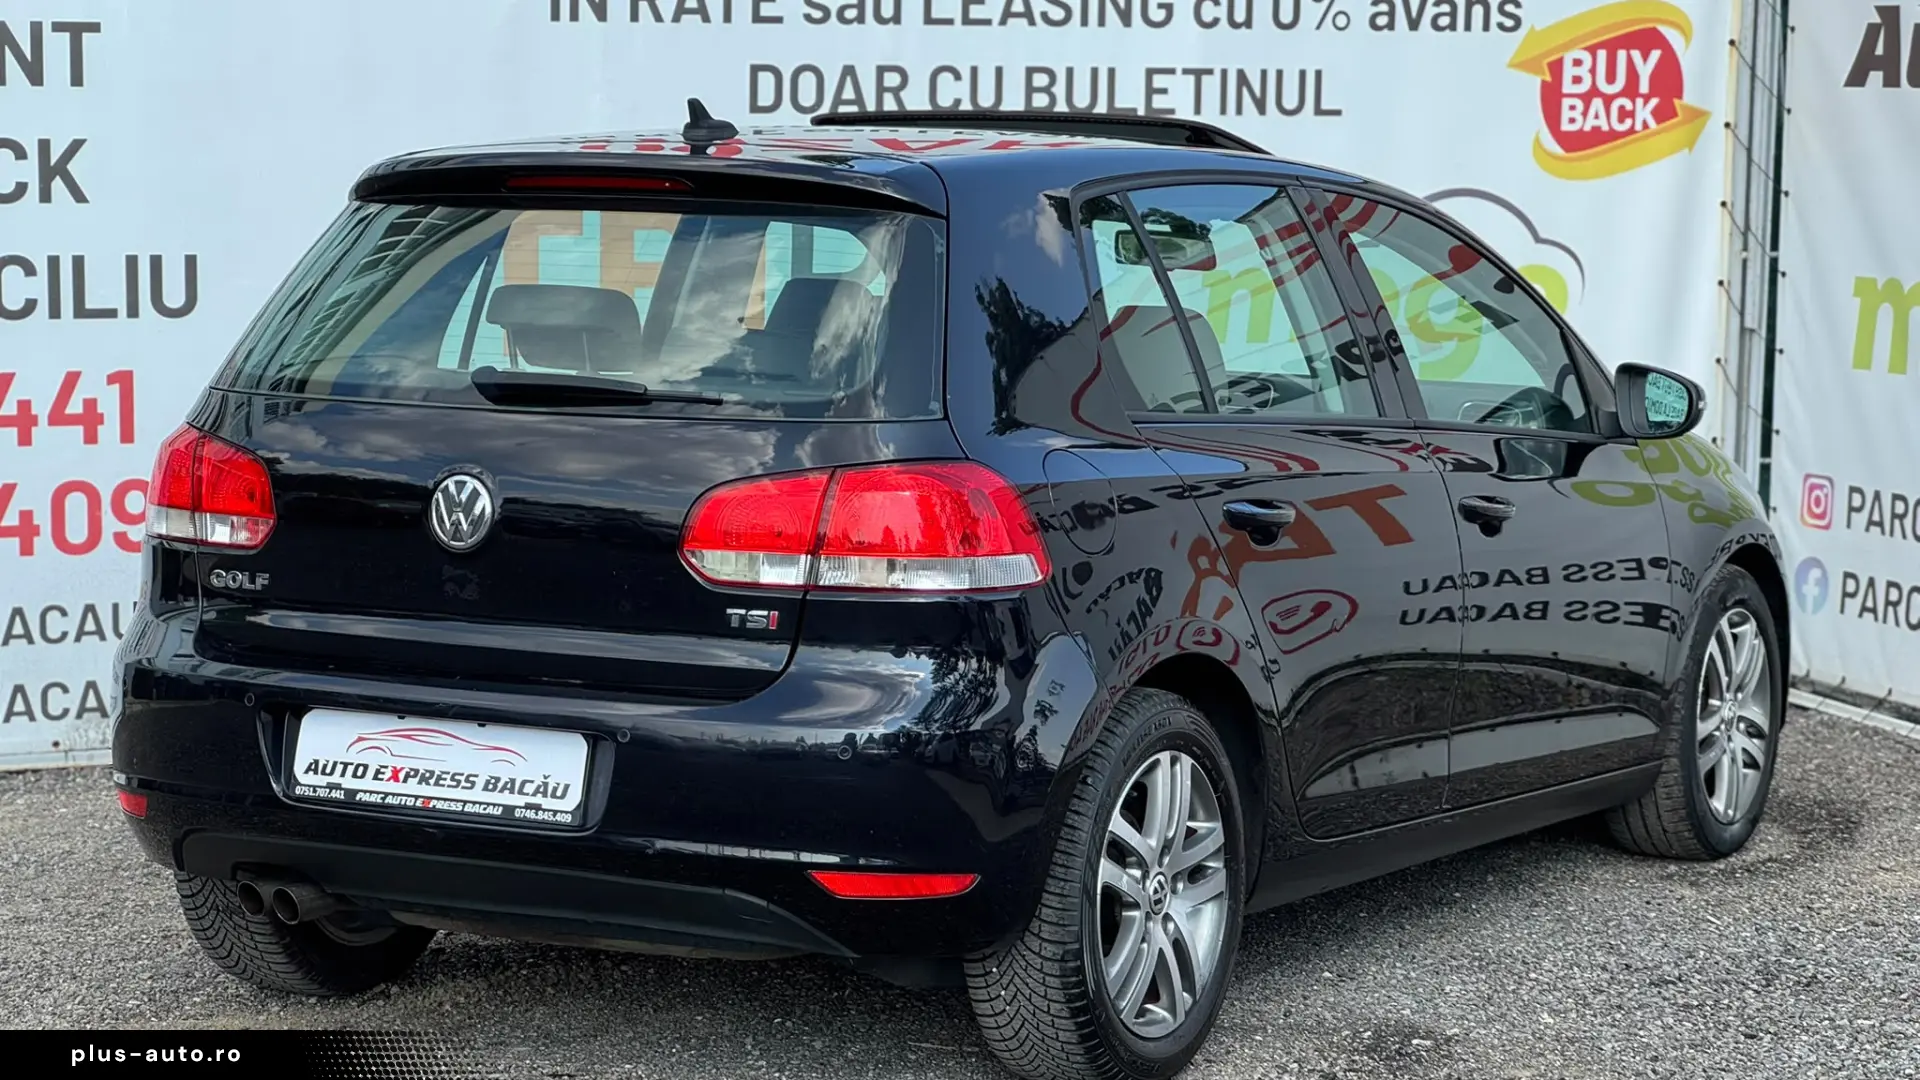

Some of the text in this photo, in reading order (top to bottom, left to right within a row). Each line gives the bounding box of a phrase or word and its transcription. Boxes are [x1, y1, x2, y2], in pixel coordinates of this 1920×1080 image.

[1193, 0, 1253, 30] cu
[1368, 0, 1523, 32] avans
[749, 63, 1343, 117] DOAR CU BULETINUL
[1561, 48, 1662, 95] BUY
[1560, 97, 1660, 133] BACK
[0, 137, 91, 205] CK
[0, 254, 198, 320] CILIU
[0, 369, 135, 447] 441
[0, 478, 151, 557] 409
[209, 569, 270, 591] GOLF
[1839, 570, 1920, 631] PARC
[726, 608, 778, 629] TSI
[294, 785, 345, 799] 0751.707.441
[303, 758, 571, 800] AUTO EXPRESS BACĂU
[356, 791, 504, 816] PARC AUTO EXPRESS BACAU
[514, 808, 572, 823] 0746.845.409
